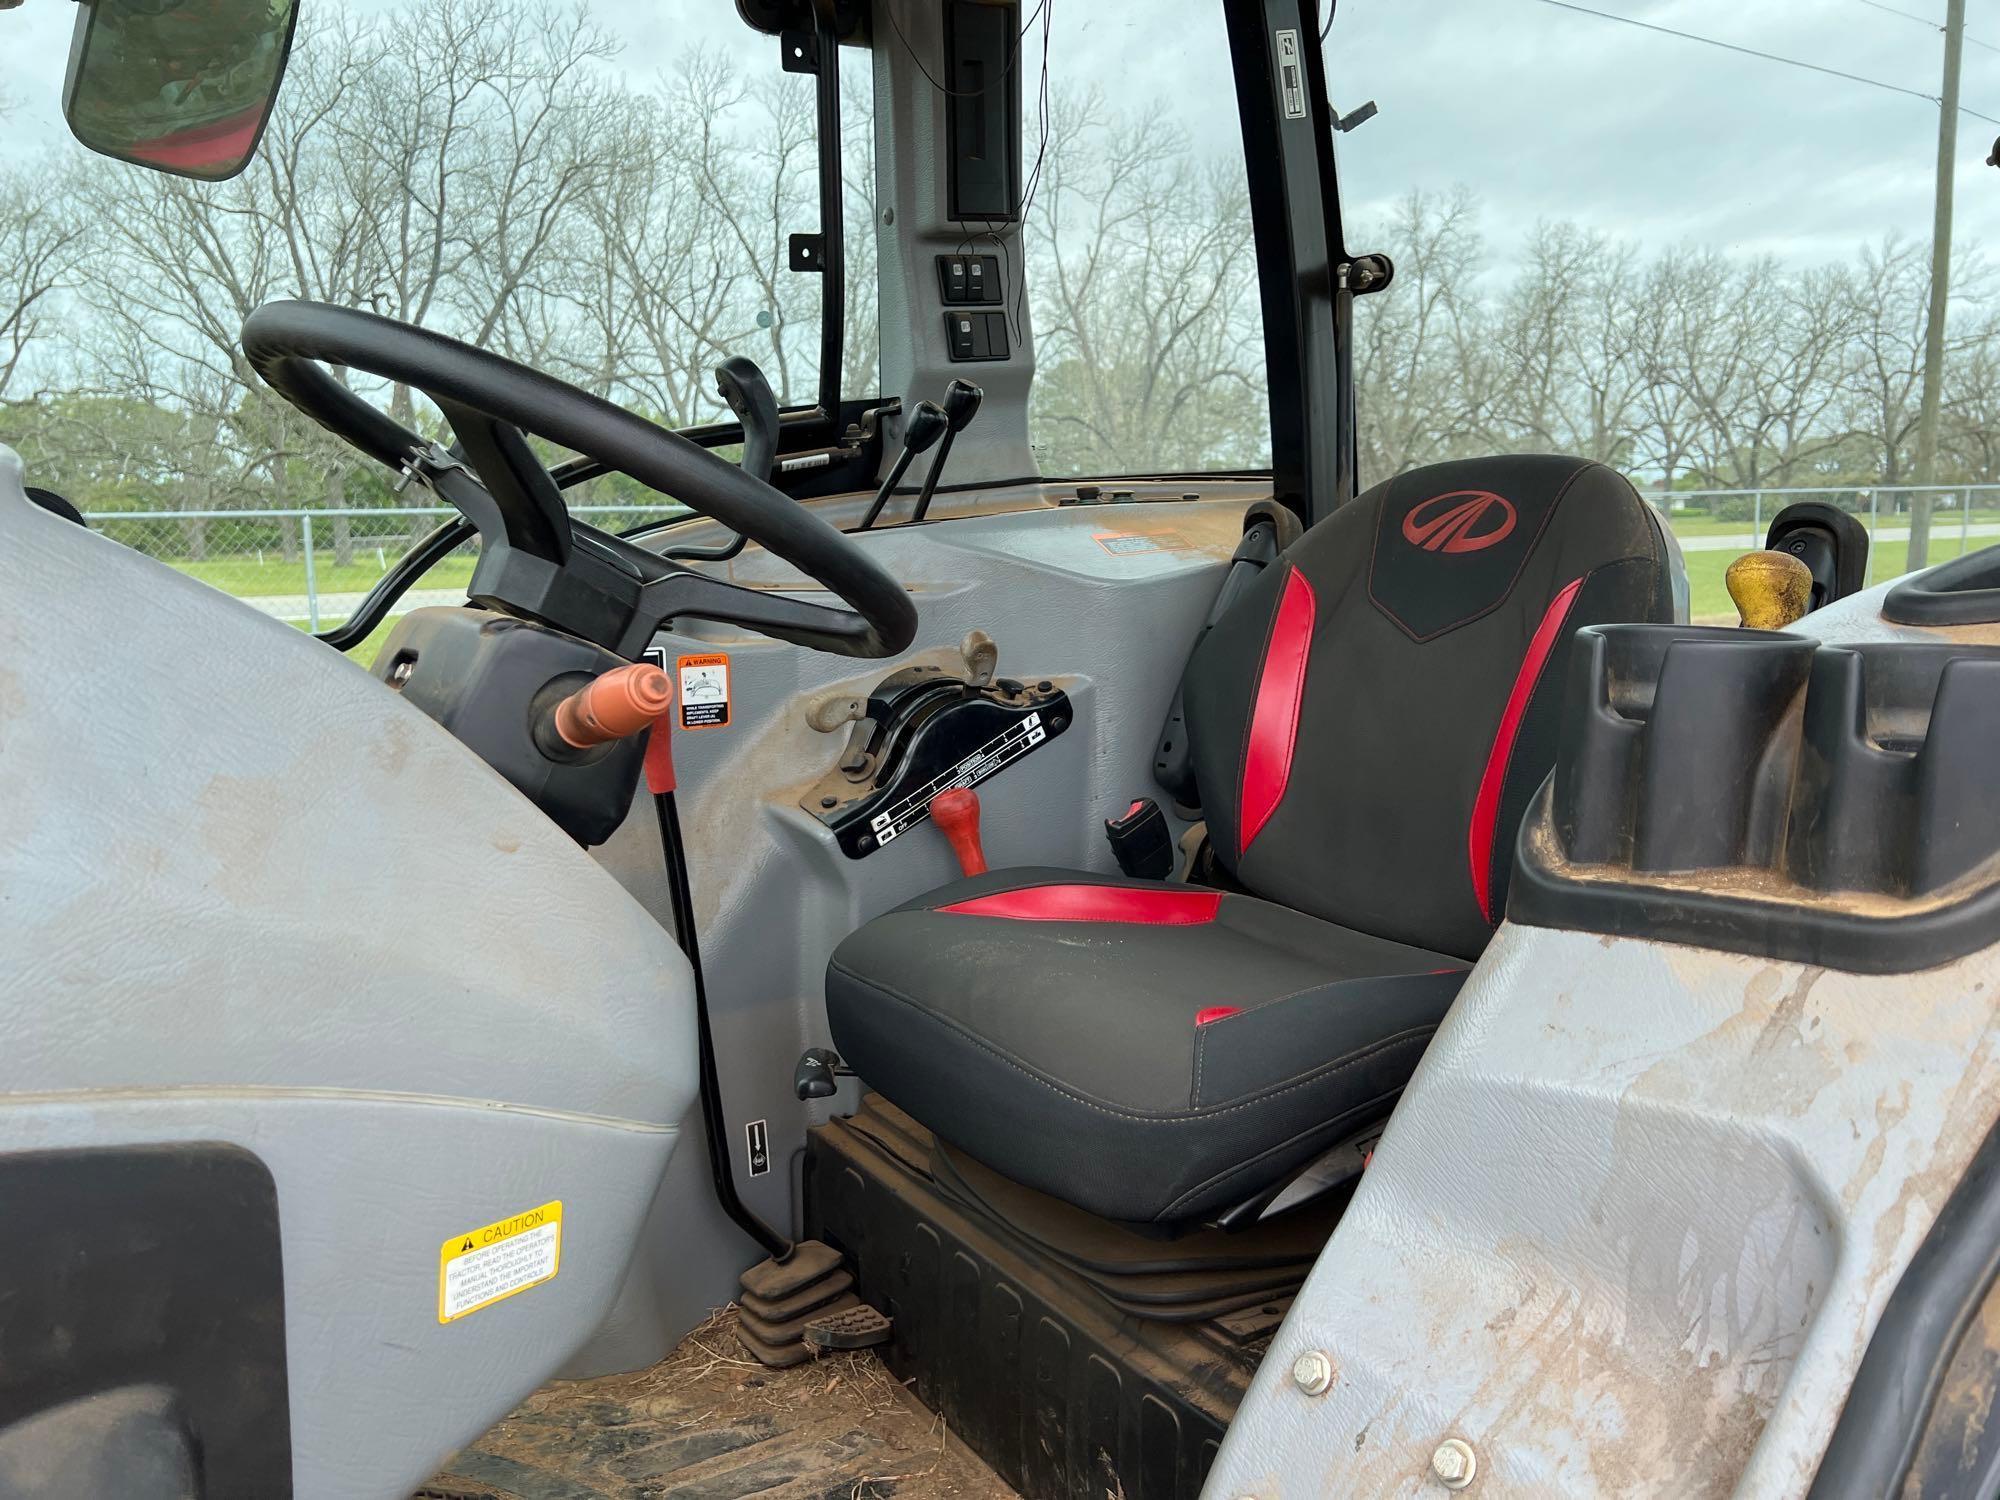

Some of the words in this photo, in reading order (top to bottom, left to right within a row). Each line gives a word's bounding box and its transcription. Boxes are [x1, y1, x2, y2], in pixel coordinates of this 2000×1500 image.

[694, 657, 721, 665] WARNING
[898, 822, 908, 831] OFF
[483, 1210, 544, 1243] CAUTION
[464, 1249, 490, 1265] BEFORE
[492, 1234, 528, 1256] OPERATING
[529, 1228, 543, 1241] THE
[483, 1255, 502, 1269] READ
[503, 1249, 516, 1262] THE
[452, 1276, 499, 1302] UNDERSTAND
[500, 1268, 512, 1281] THE
[513, 1256, 550, 1277] IMPORTANT
[460, 1271, 488, 1287] MANUAL
[490, 1255, 532, 1276] THOROUGHLY
[534, 1249, 544, 1259] TO
[456, 1288, 495, 1310] FUNCTIONS
[495, 1281, 510, 1294] AND
